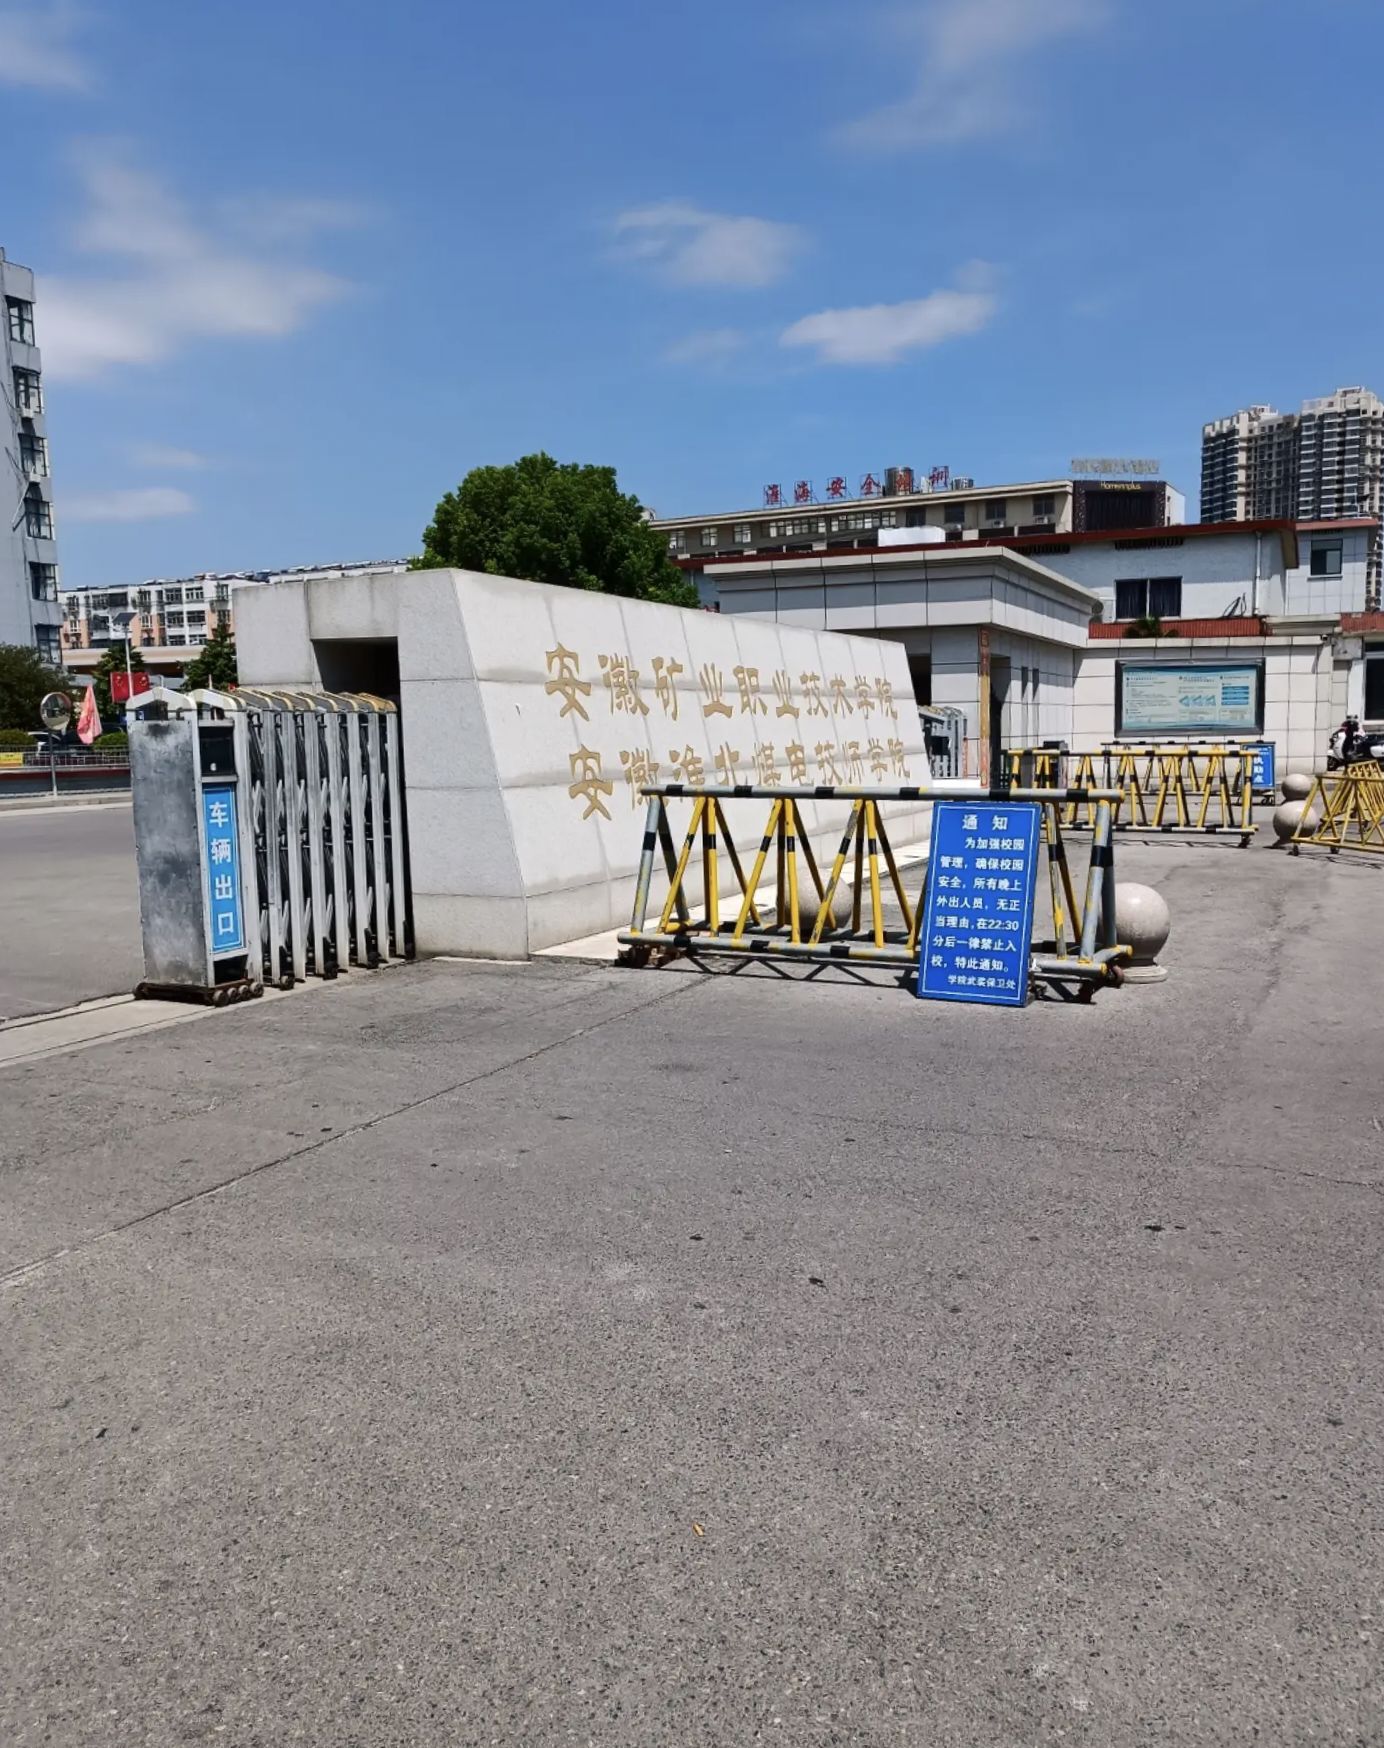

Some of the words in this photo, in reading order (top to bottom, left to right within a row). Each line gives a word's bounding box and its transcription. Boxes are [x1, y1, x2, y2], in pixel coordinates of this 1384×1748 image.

[545, 642, 898, 721] 安徽矿业职业技术学院
[569, 738, 911, 821] 安徽淮北煤电技师学院
[962, 814, 1008, 830] 通知
[965, 837, 1025, 851] 为加强校园
[209, 801, 234, 935] 车辆出口
[940, 855, 1024, 871] 管理，确保校园
[938, 876, 1022, 892] 安全，所有晚上
[936, 896, 1020, 912] 外出人员，无正
[933, 935, 1017, 952] 分后一律禁止入
[931, 954, 1009, 972] 校，特此通知。
